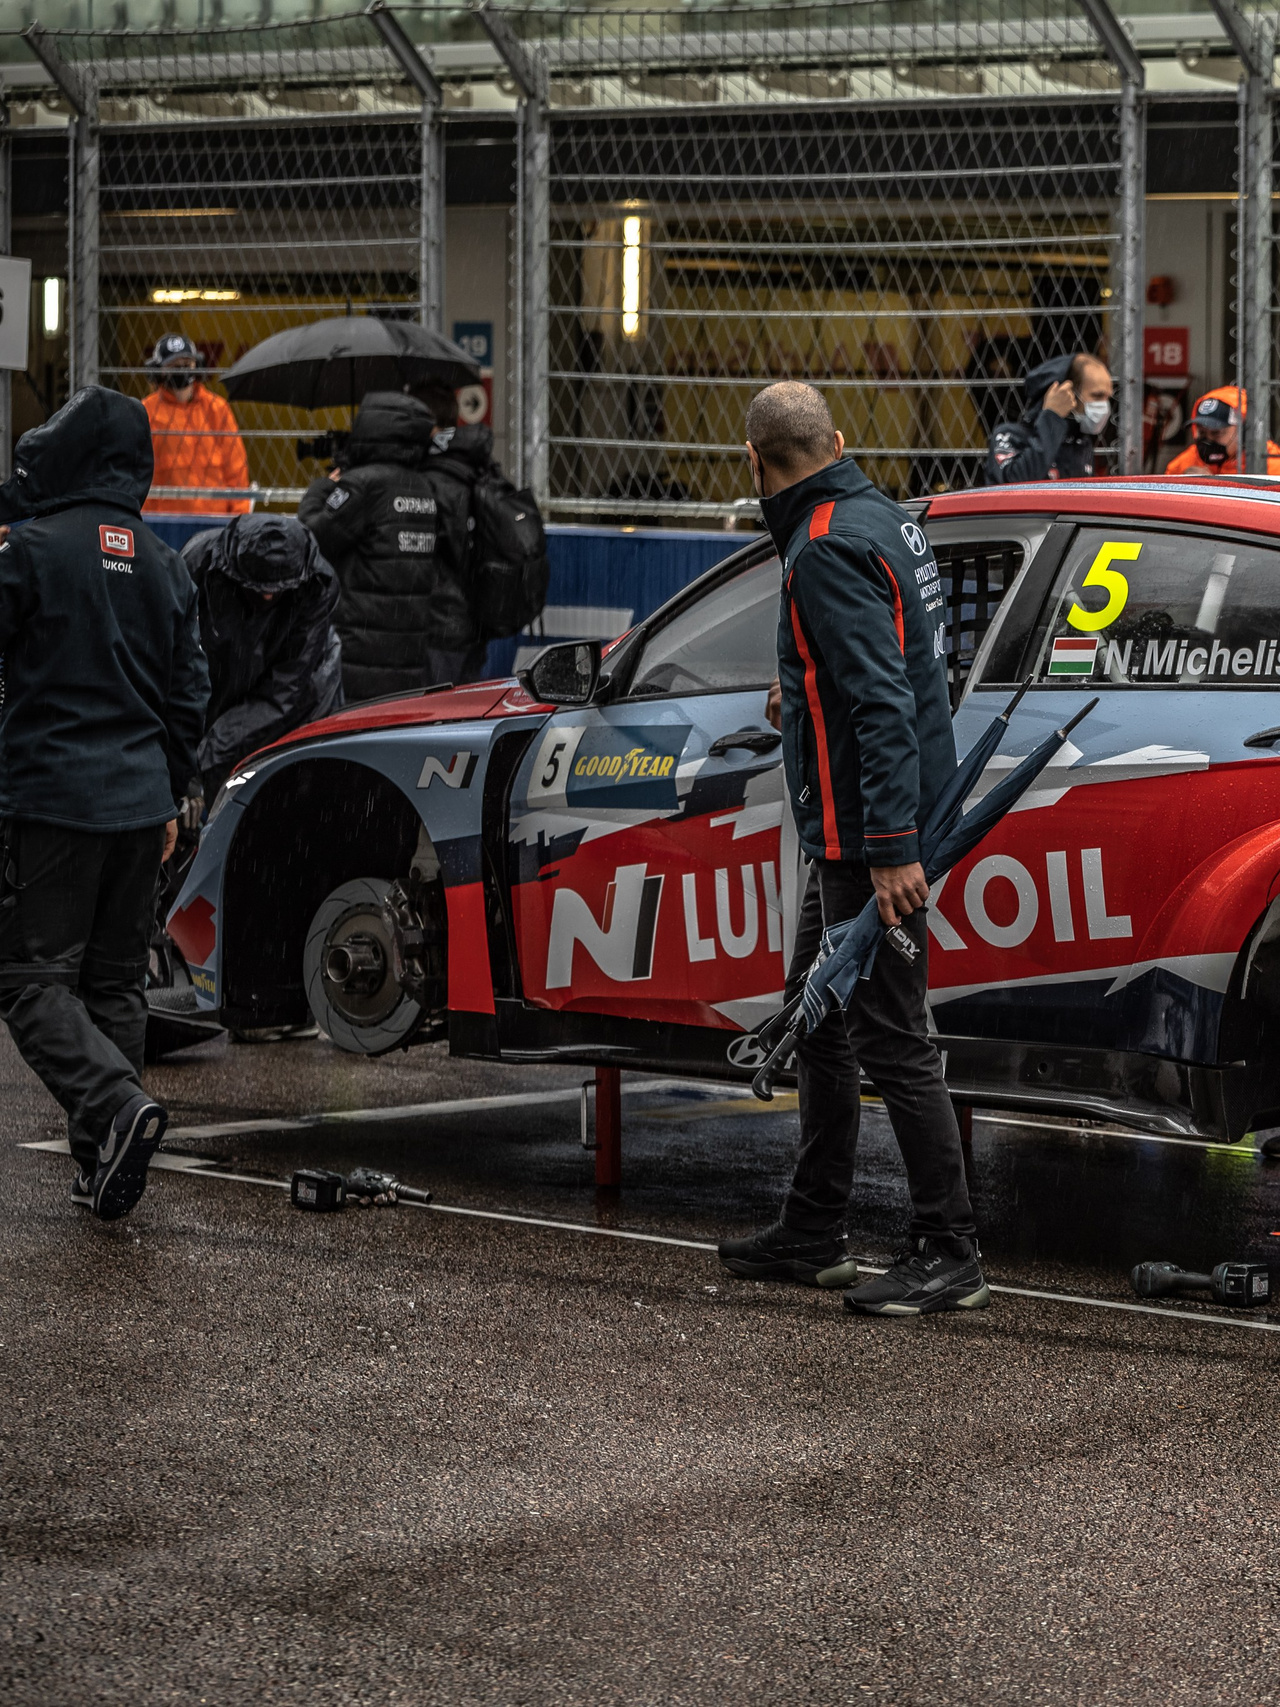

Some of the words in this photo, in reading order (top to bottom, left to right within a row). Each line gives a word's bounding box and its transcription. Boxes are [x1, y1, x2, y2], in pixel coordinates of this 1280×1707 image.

[1148, 342, 1183, 366] 18
[108, 535, 126, 546] BRC
[102, 558, 133, 574] LUKOIL
[1066, 541, 1143, 632] 5
[541, 743, 566, 789] 5
